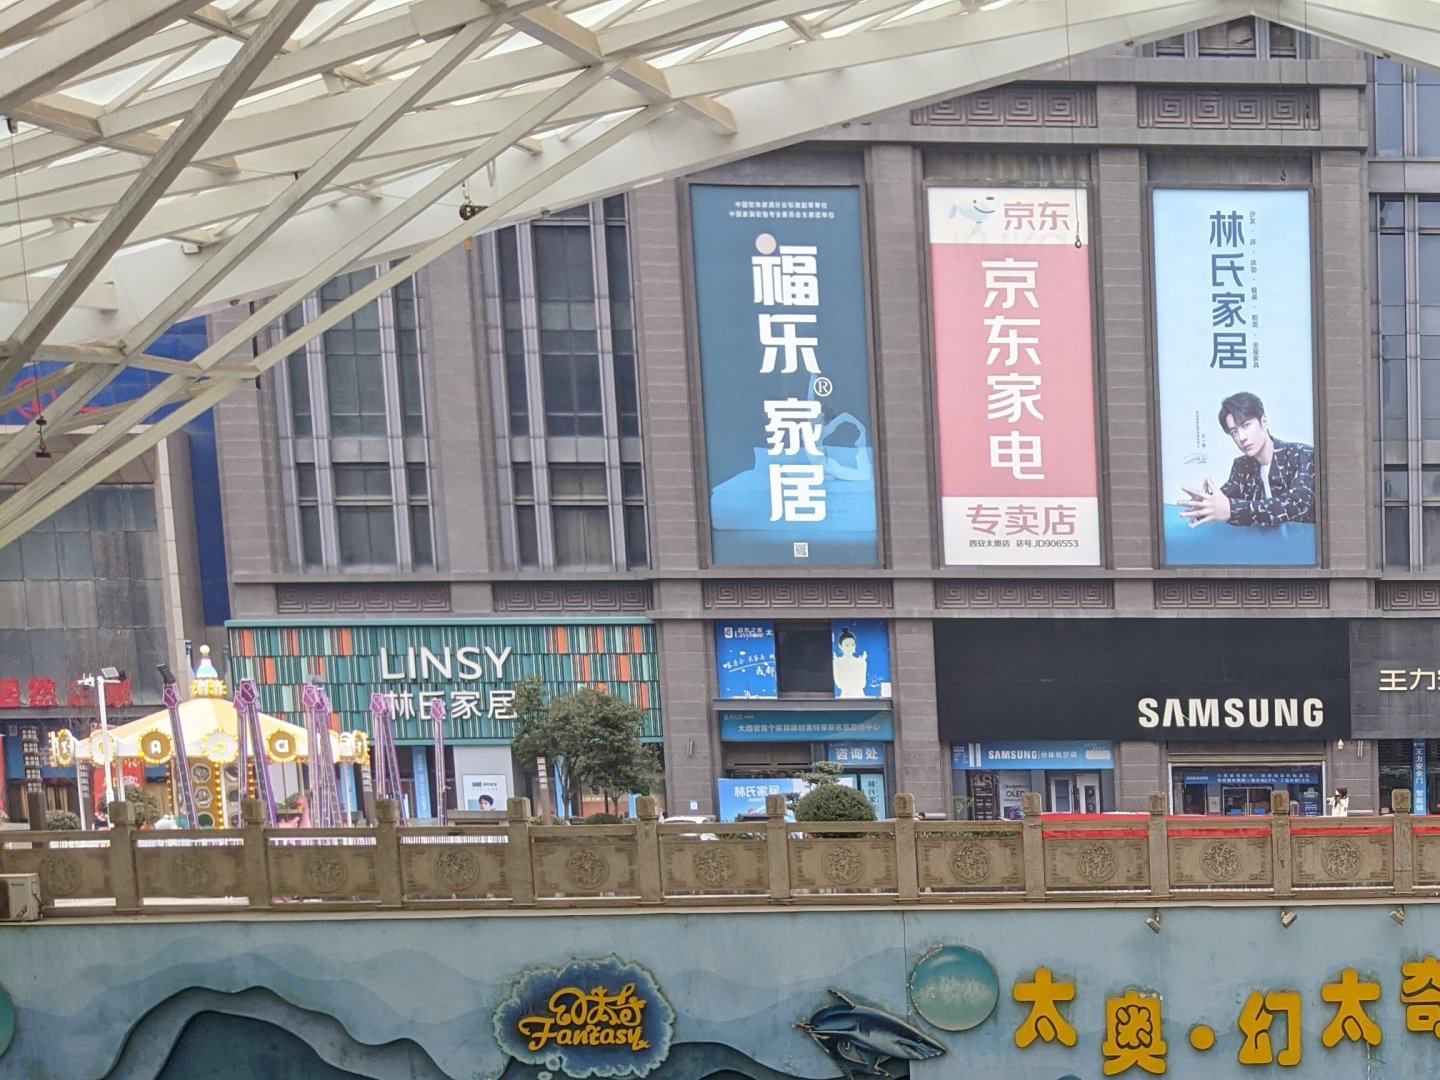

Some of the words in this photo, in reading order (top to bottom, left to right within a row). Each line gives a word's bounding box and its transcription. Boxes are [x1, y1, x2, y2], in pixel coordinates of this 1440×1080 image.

[1003, 201, 1070, 231] 京东
[1209, 210, 1247, 369] 林氏家居
[981, 258, 1045, 480] 京东家电
[966, 504, 1077, 536] 专卖店
[381, 645, 512, 680] LINSY
[1138, 697, 1325, 728] SAMSUNG
[836, 748, 878, 761] 咨询处
[988, 750, 1038, 760] SAMSUNG
[518, 1017, 650, 1051] Fantasy
